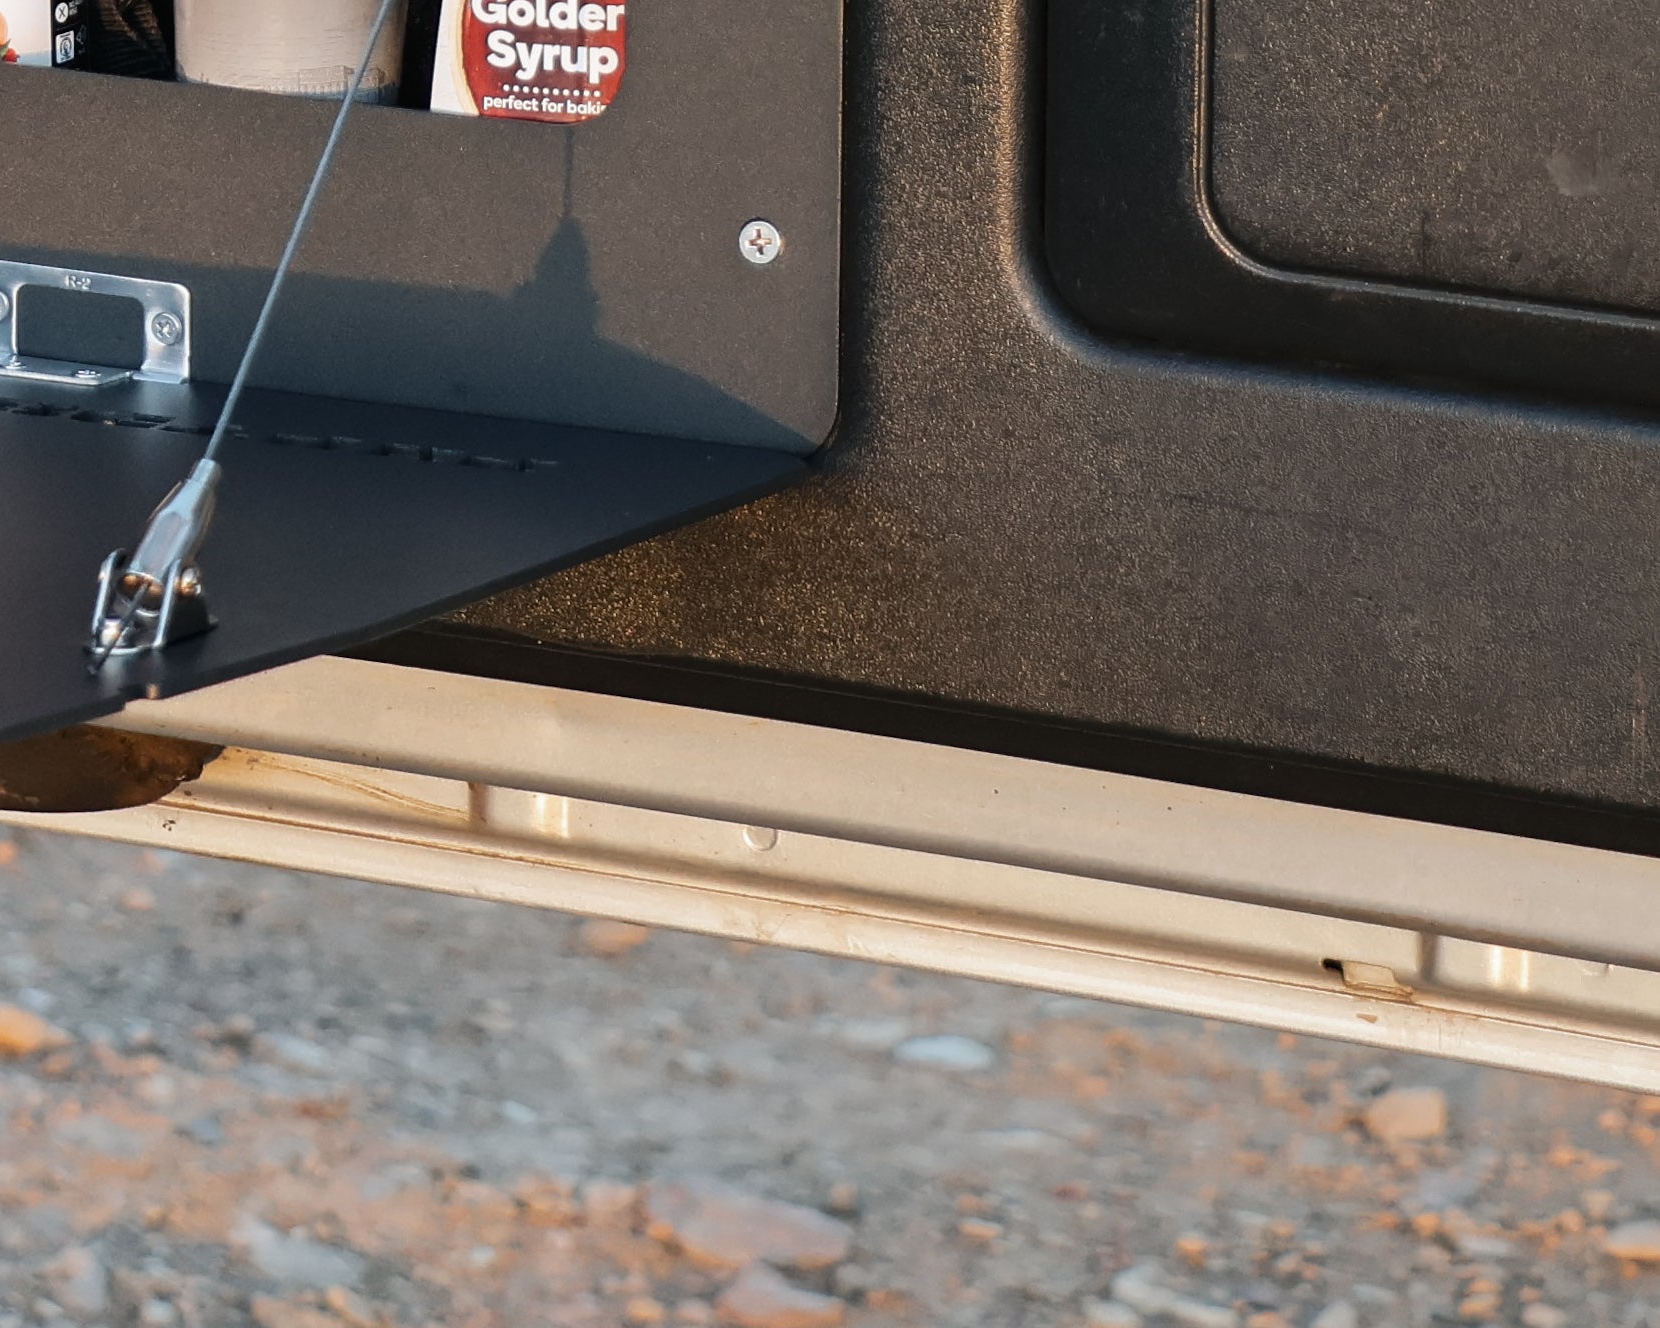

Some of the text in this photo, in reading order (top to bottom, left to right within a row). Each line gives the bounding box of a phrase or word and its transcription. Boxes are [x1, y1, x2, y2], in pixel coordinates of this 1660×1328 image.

[487, 29, 618, 84] Syrup
[483, 95, 607, 114] perfect for baki
